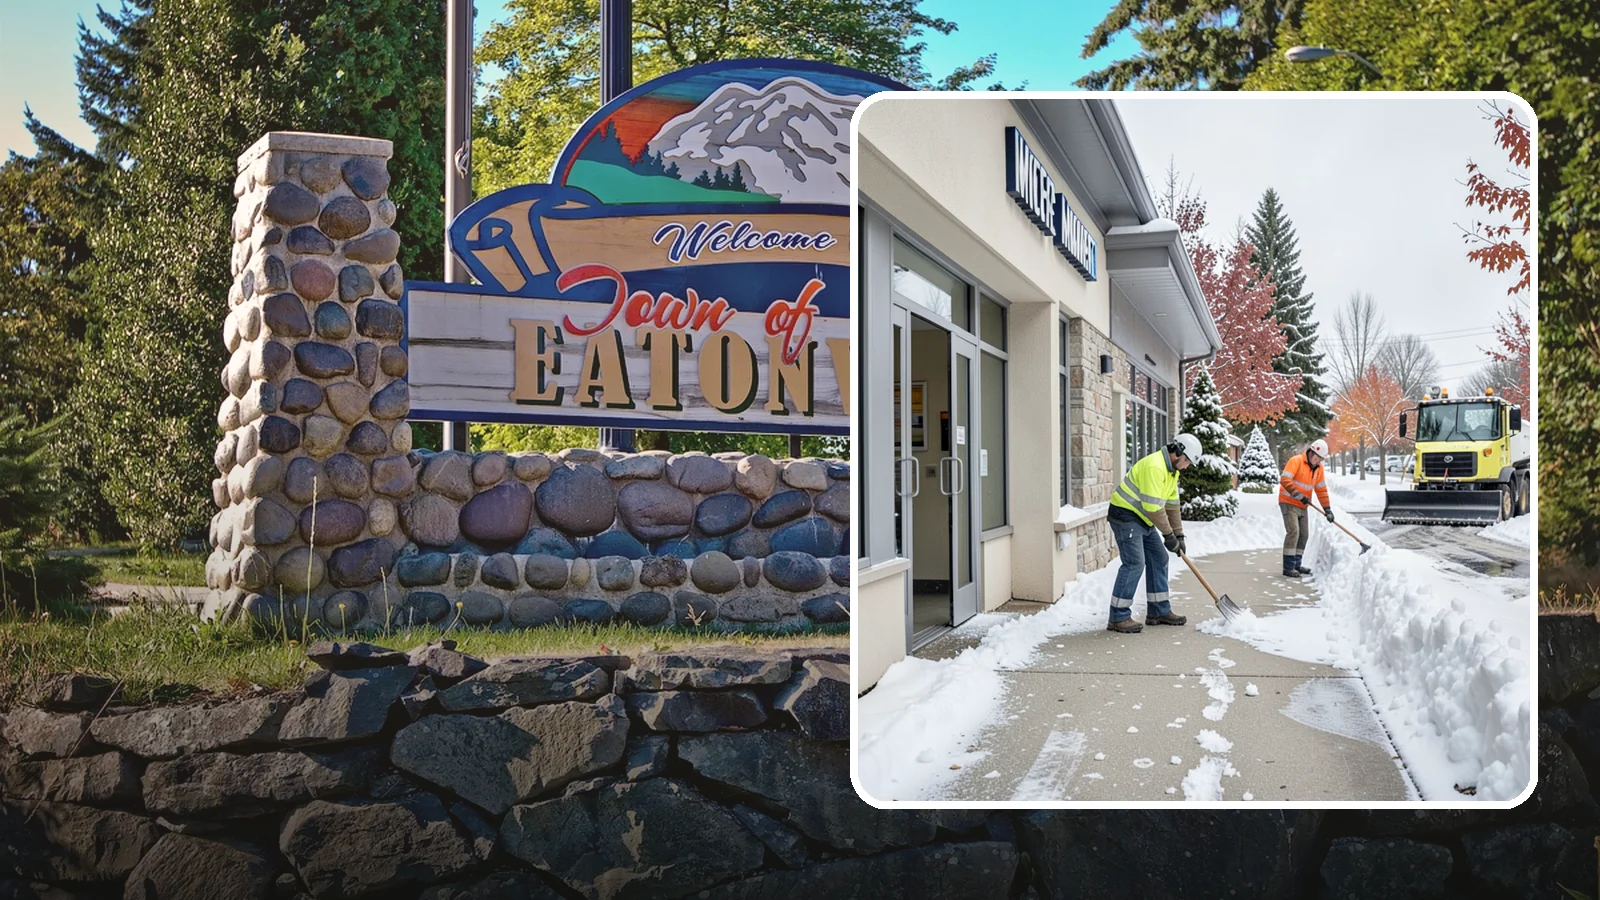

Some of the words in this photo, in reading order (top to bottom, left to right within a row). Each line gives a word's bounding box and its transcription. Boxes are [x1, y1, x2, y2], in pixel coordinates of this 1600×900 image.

[653, 220, 838, 264] Welcome
[556, 263, 736, 336] Town
[764, 278, 827, 366] of
